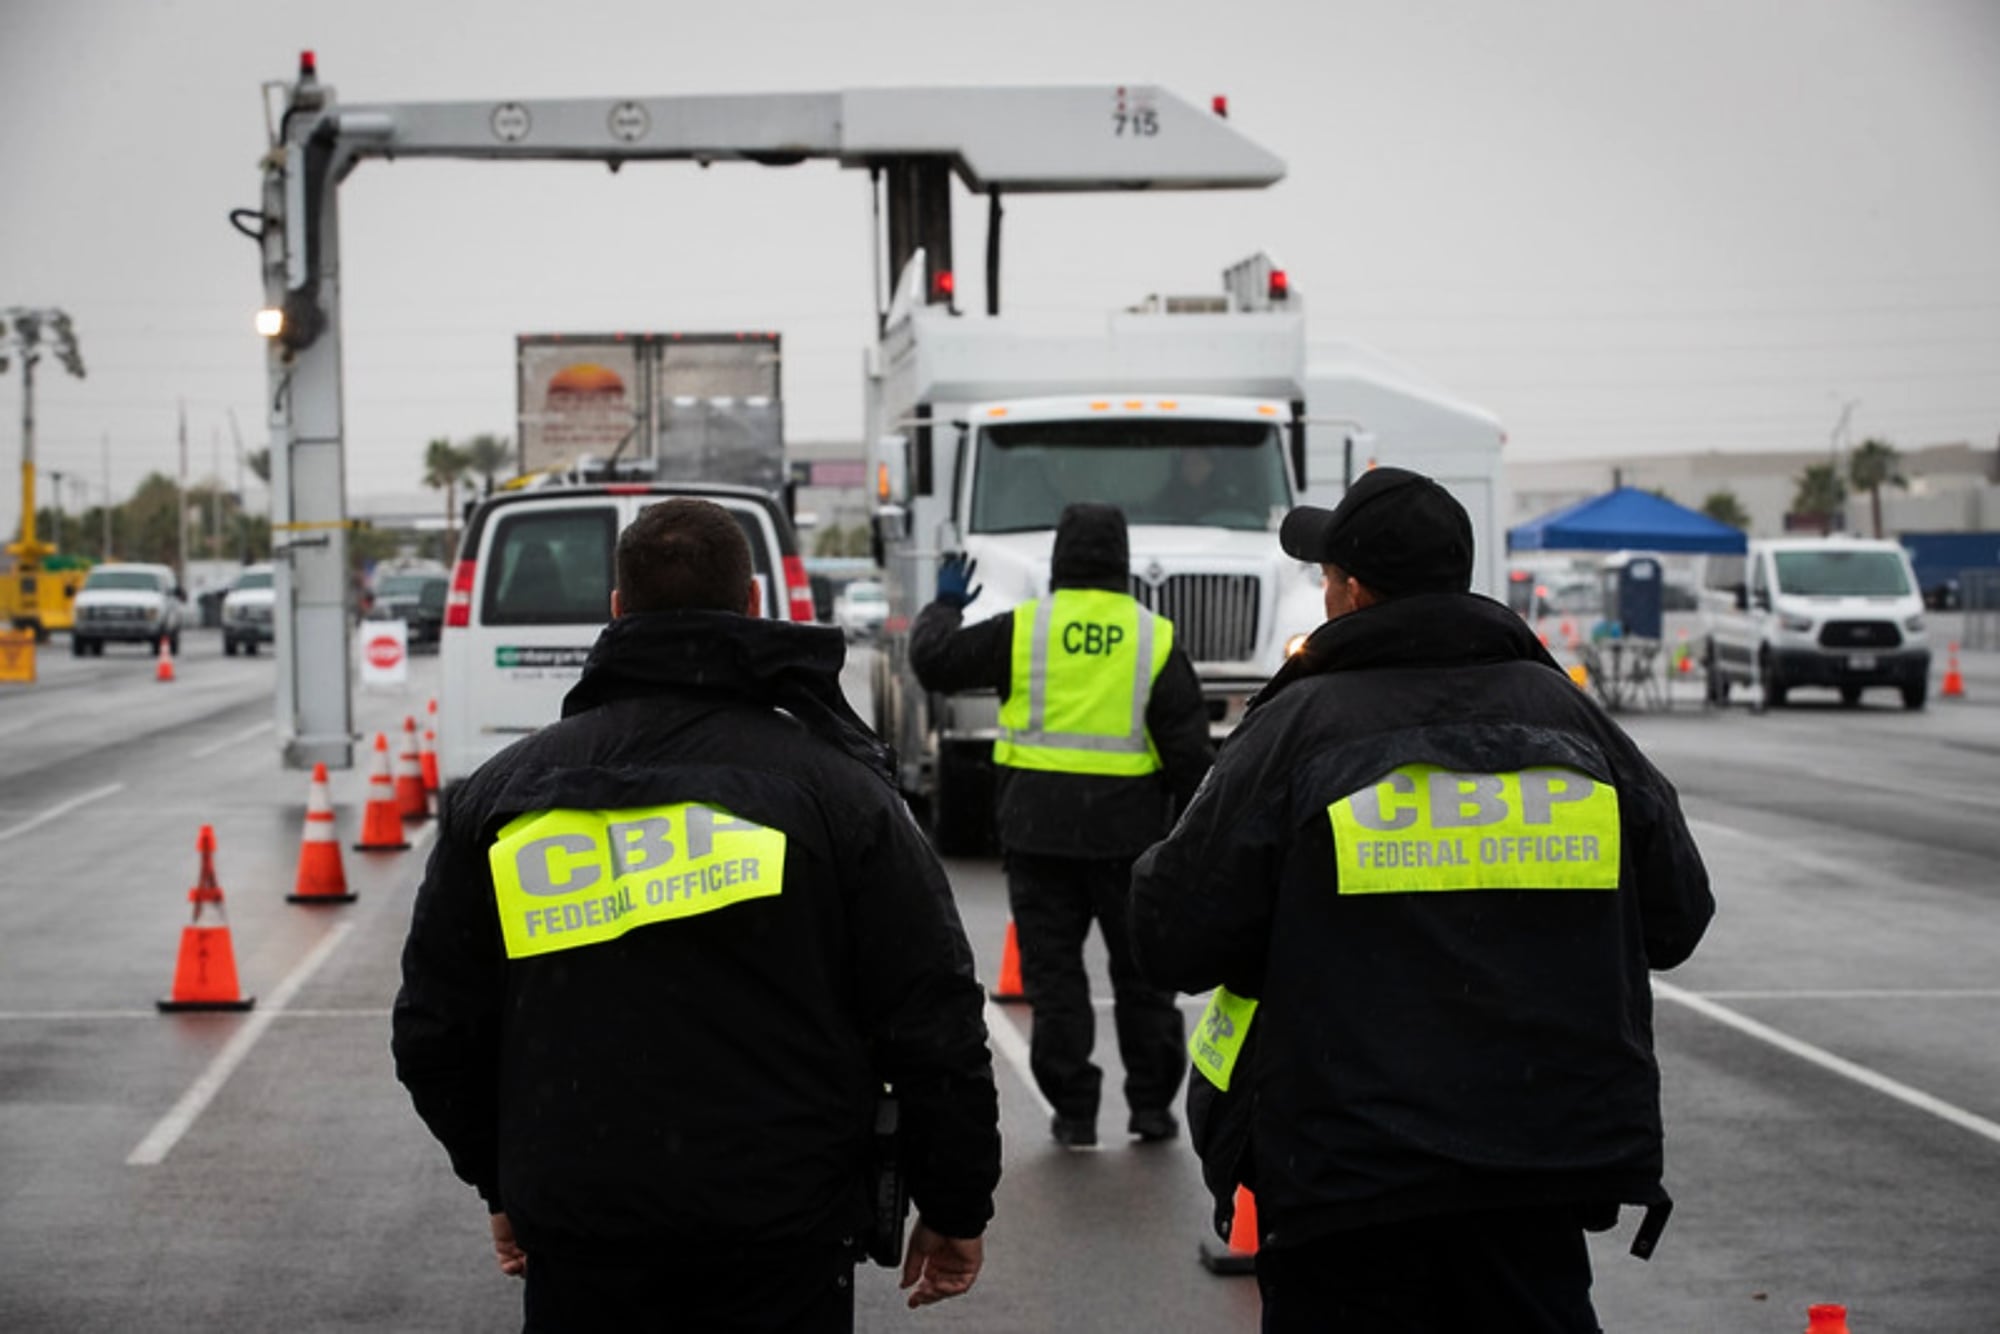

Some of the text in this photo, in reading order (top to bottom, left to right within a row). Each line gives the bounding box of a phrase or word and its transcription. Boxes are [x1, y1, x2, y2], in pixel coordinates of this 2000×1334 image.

[1111, 108, 1159, 138] 715
[1062, 621, 1124, 656] CBP
[1350, 769, 1595, 832] CBP
[1357, 835, 1600, 869] FEDERAL OFFICER
[525, 858, 760, 938] FEDERAL OFFICER
